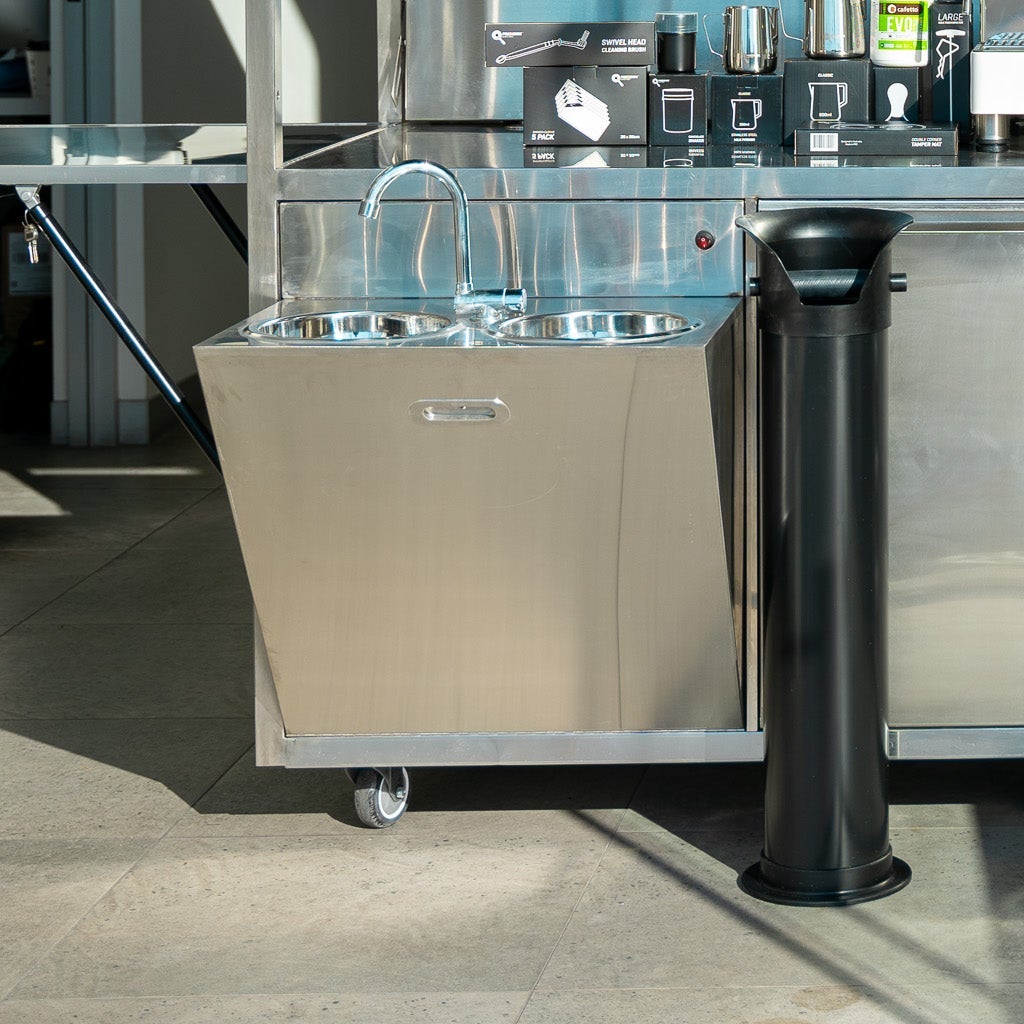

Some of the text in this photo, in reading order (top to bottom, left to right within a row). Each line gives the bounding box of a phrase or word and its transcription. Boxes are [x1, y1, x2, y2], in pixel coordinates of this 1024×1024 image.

[937, 12, 964, 21] LARGE
[887, 16, 913, 32] EVO
[601, 38, 647, 46] SWIVEL HEAD
[531, 133, 555, 141] 5 PACK
